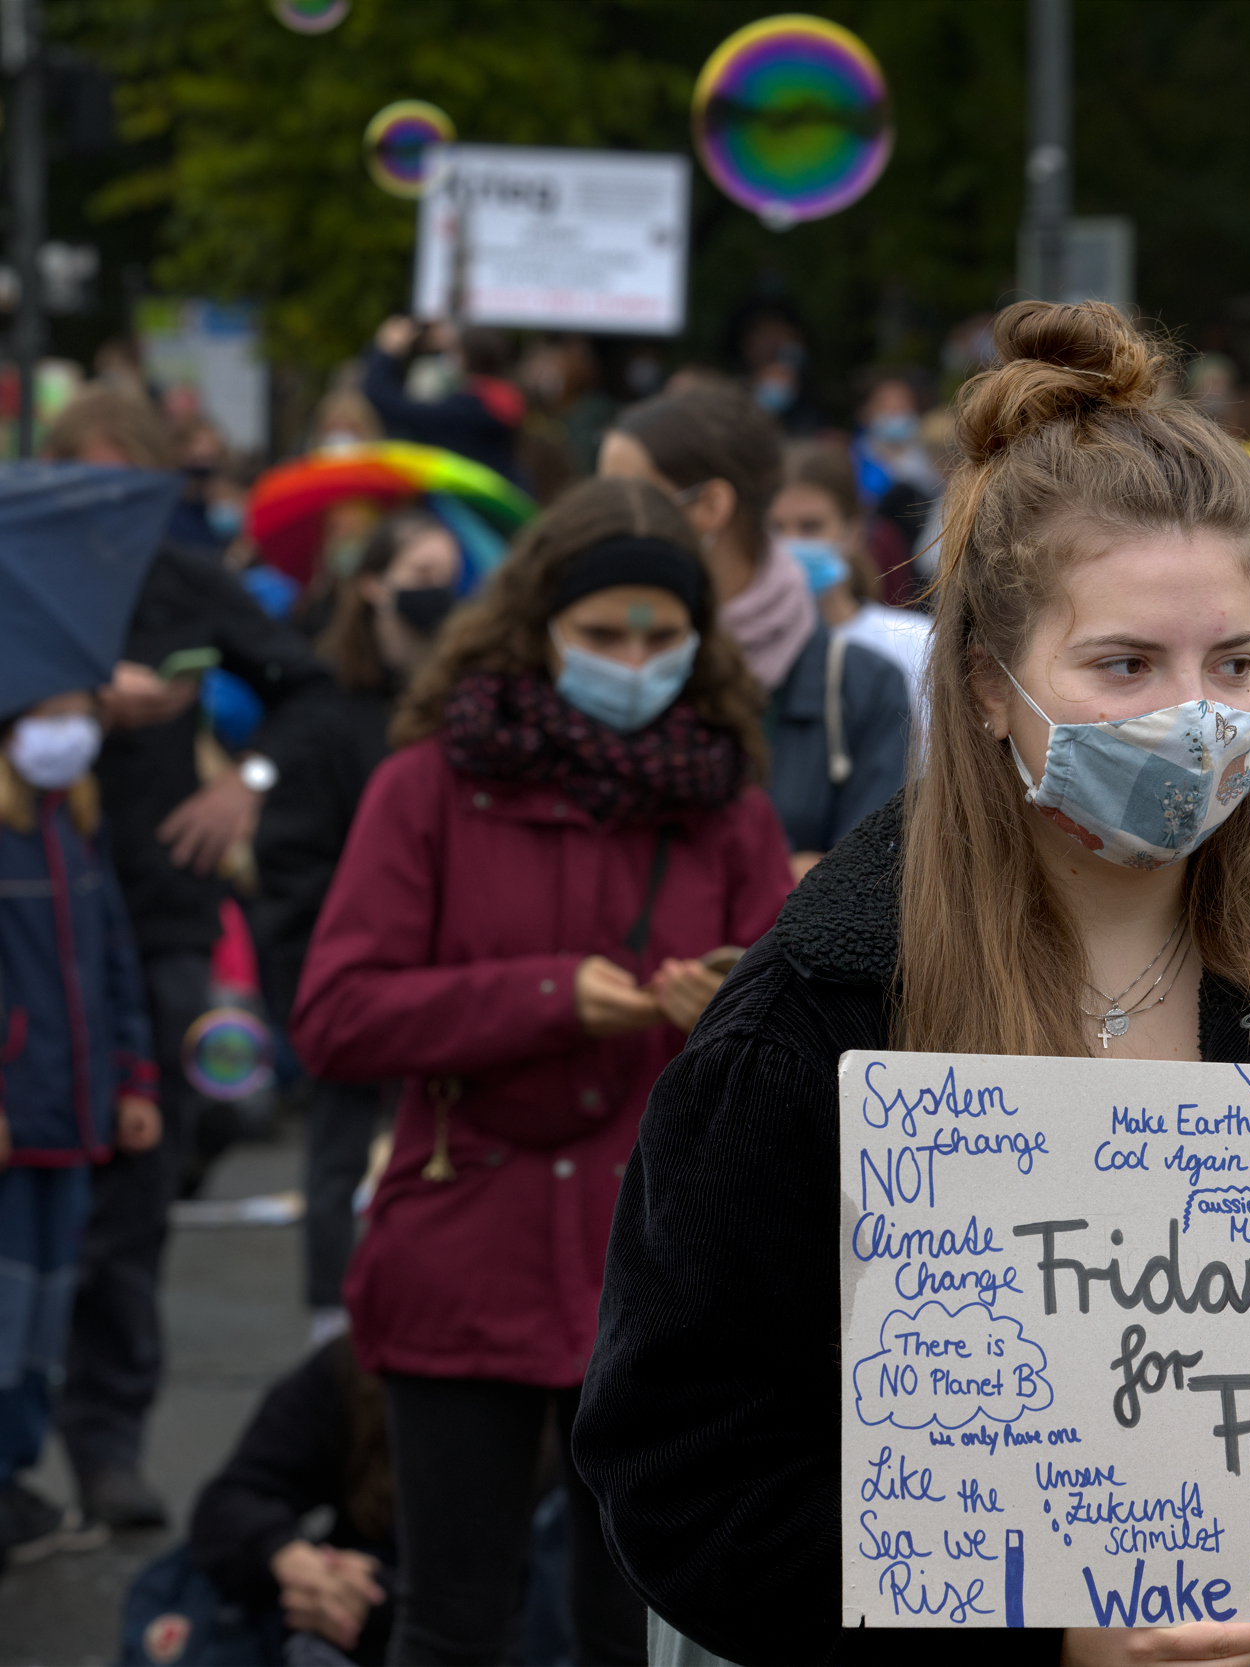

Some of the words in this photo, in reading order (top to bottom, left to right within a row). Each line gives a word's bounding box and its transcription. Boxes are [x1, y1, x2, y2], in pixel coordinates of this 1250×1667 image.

[863, 1061, 1019, 1137] System
[1111, 1105, 1169, 1137] Make
[860, 1143, 952, 1211] NOT
[1094, 1141, 1149, 1172] Cool
[1164, 1146, 1248, 1186] Again
[853, 1212, 1004, 1262] Climate
[895, 1332, 973, 1358] There
[987, 1334, 1005, 1357] is
[880, 1363, 918, 1397] NO
[930, 1368, 1004, 1396] Planet
[1013, 1363, 1037, 1397] B
[1111, 1324, 1204, 1428] for
[961, 1425, 998, 1455] only
[1004, 1423, 1043, 1446] have
[1048, 1427, 1082, 1444] one
[861, 1446, 946, 1502] Like
[957, 1479, 1005, 1513] the
[1036, 1461, 1127, 1490] Unsere
[1065, 1481, 1204, 1532] Zukunft
[860, 1509, 932, 1560] Sea
[945, 1529, 998, 1560] we
[879, 1560, 996, 1624] Rise
[1082, 1558, 1238, 1628] Wake
